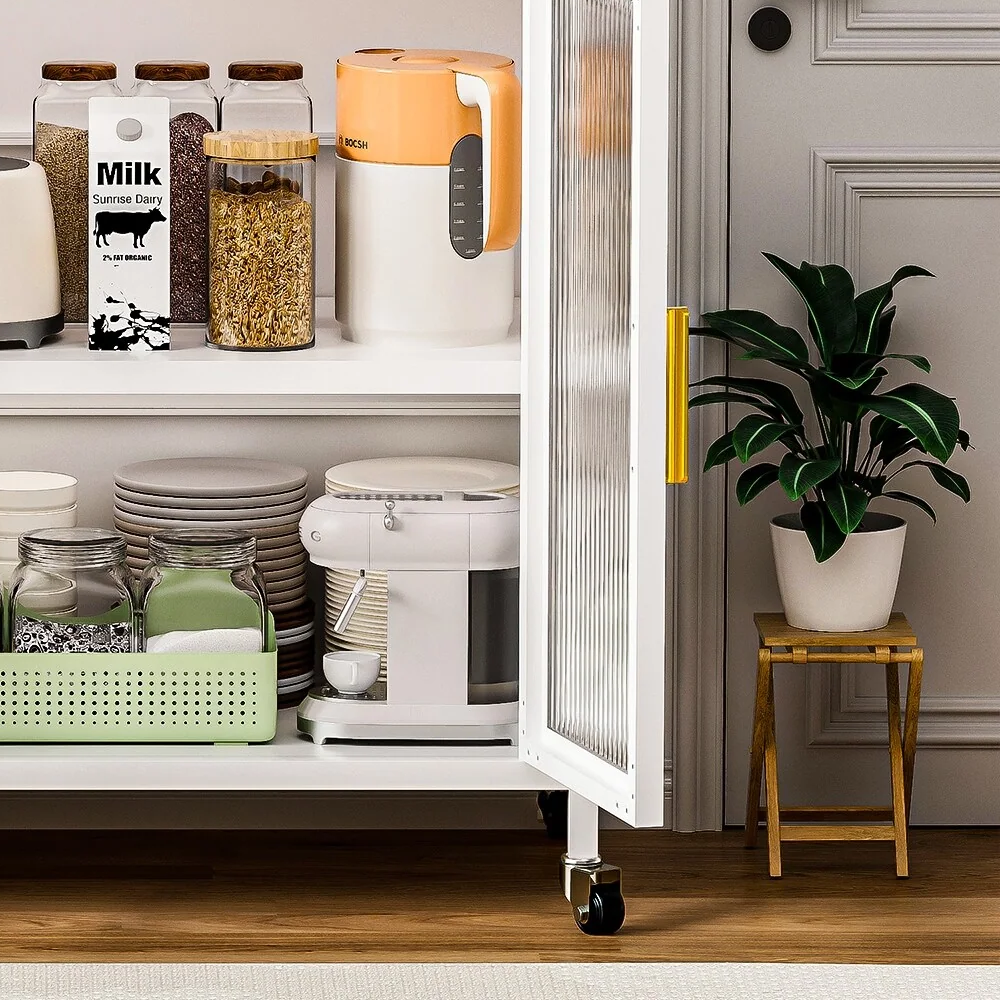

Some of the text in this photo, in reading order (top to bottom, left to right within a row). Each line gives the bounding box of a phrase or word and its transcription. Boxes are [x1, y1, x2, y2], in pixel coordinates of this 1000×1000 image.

[344, 137, 368, 150] BOCSH
[97, 162, 162, 186] Milk
[92, 194, 163, 206] Sunrise Dairy
